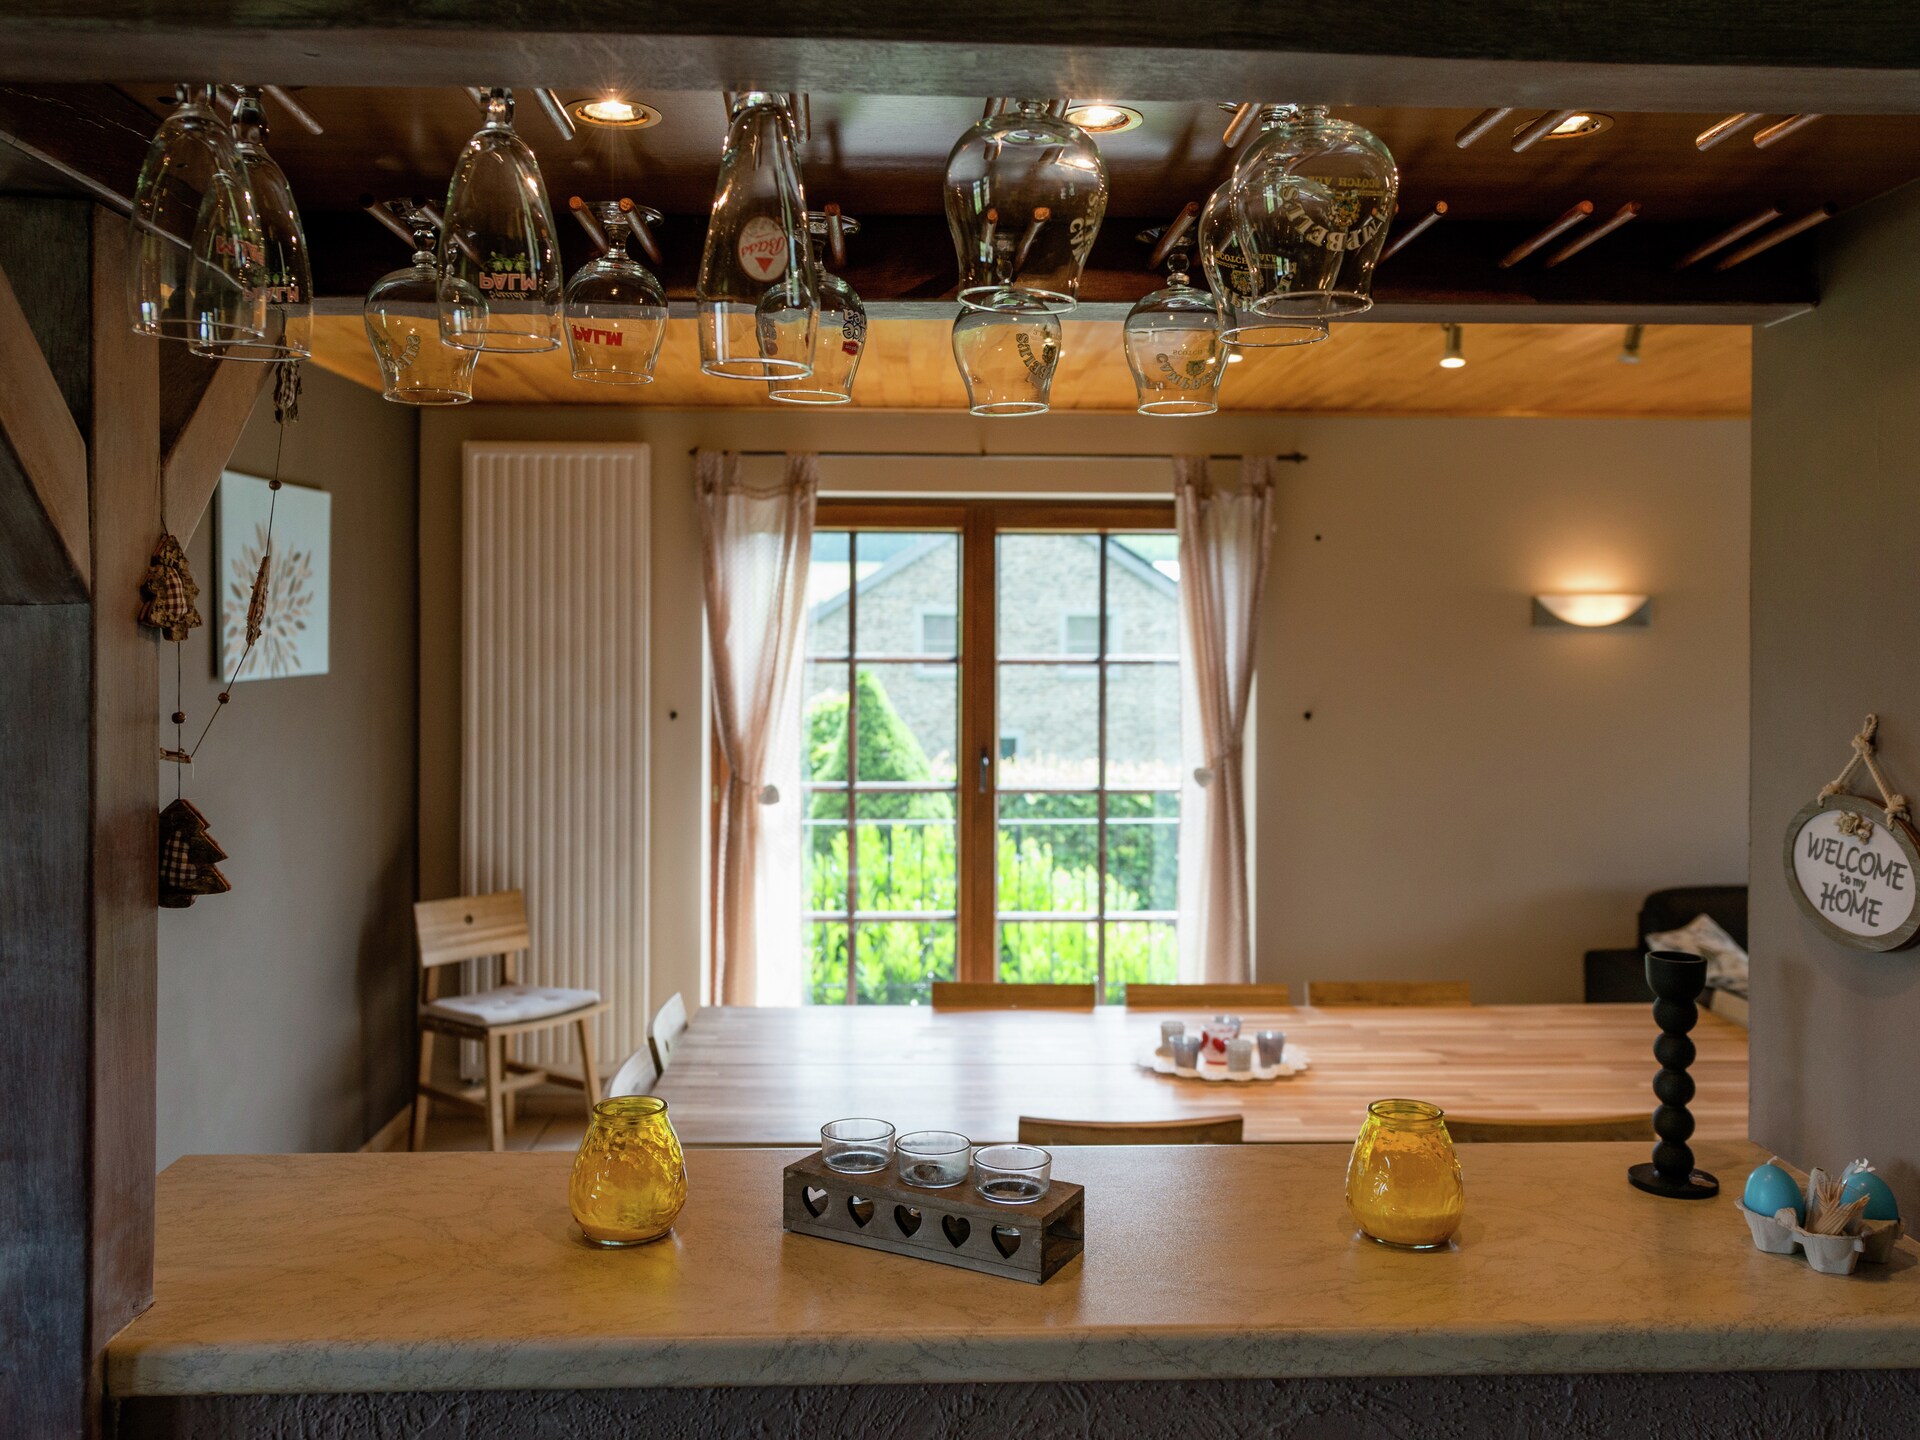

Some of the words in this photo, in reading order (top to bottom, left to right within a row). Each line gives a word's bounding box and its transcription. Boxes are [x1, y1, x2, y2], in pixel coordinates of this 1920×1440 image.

[1807, 832, 1908, 891] WELCOME
[1840, 872, 1851, 885] to
[1853, 878, 1867, 893] my
[1820, 882, 1883, 927] HOME
